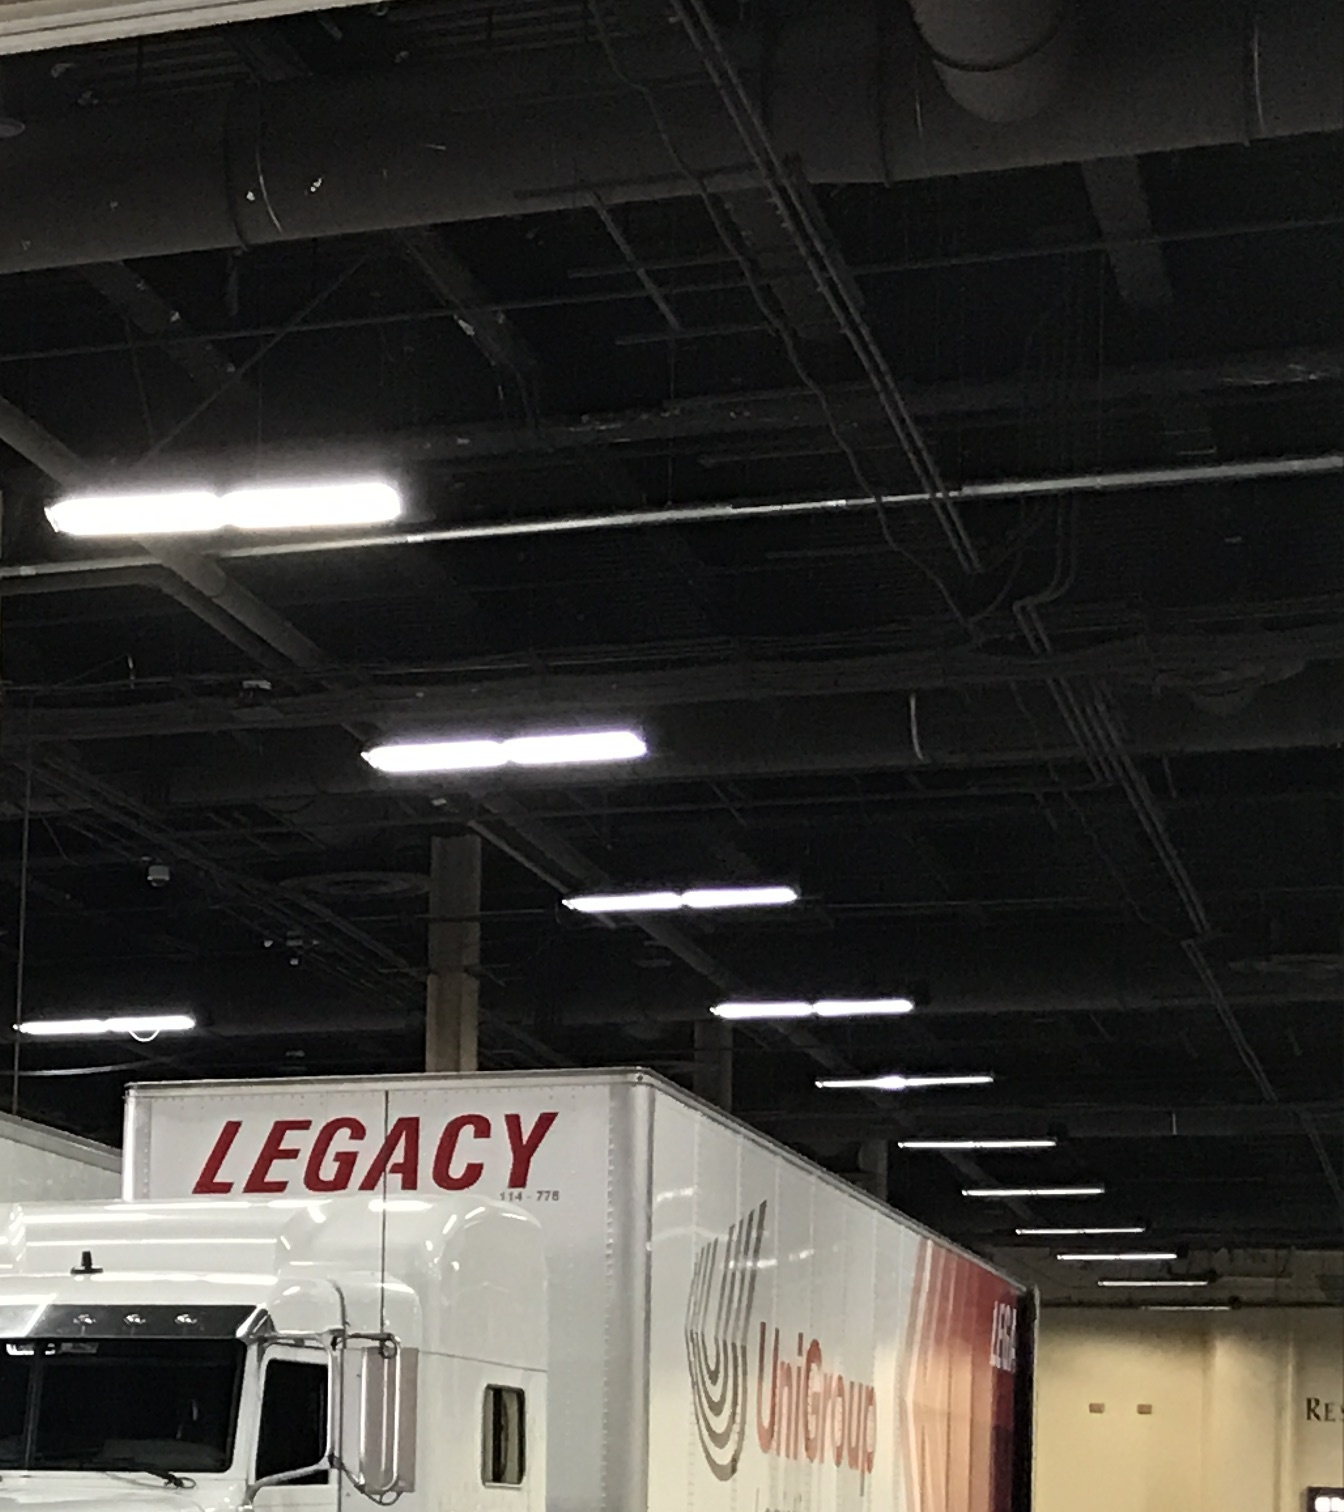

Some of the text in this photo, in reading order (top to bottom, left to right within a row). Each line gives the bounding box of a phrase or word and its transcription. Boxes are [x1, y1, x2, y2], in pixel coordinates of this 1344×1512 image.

[192, 1111, 560, 1195] LEGACY
[756, 1321, 877, 1497] UniGroup
[1305, 1396, 1344, 1423] RE
